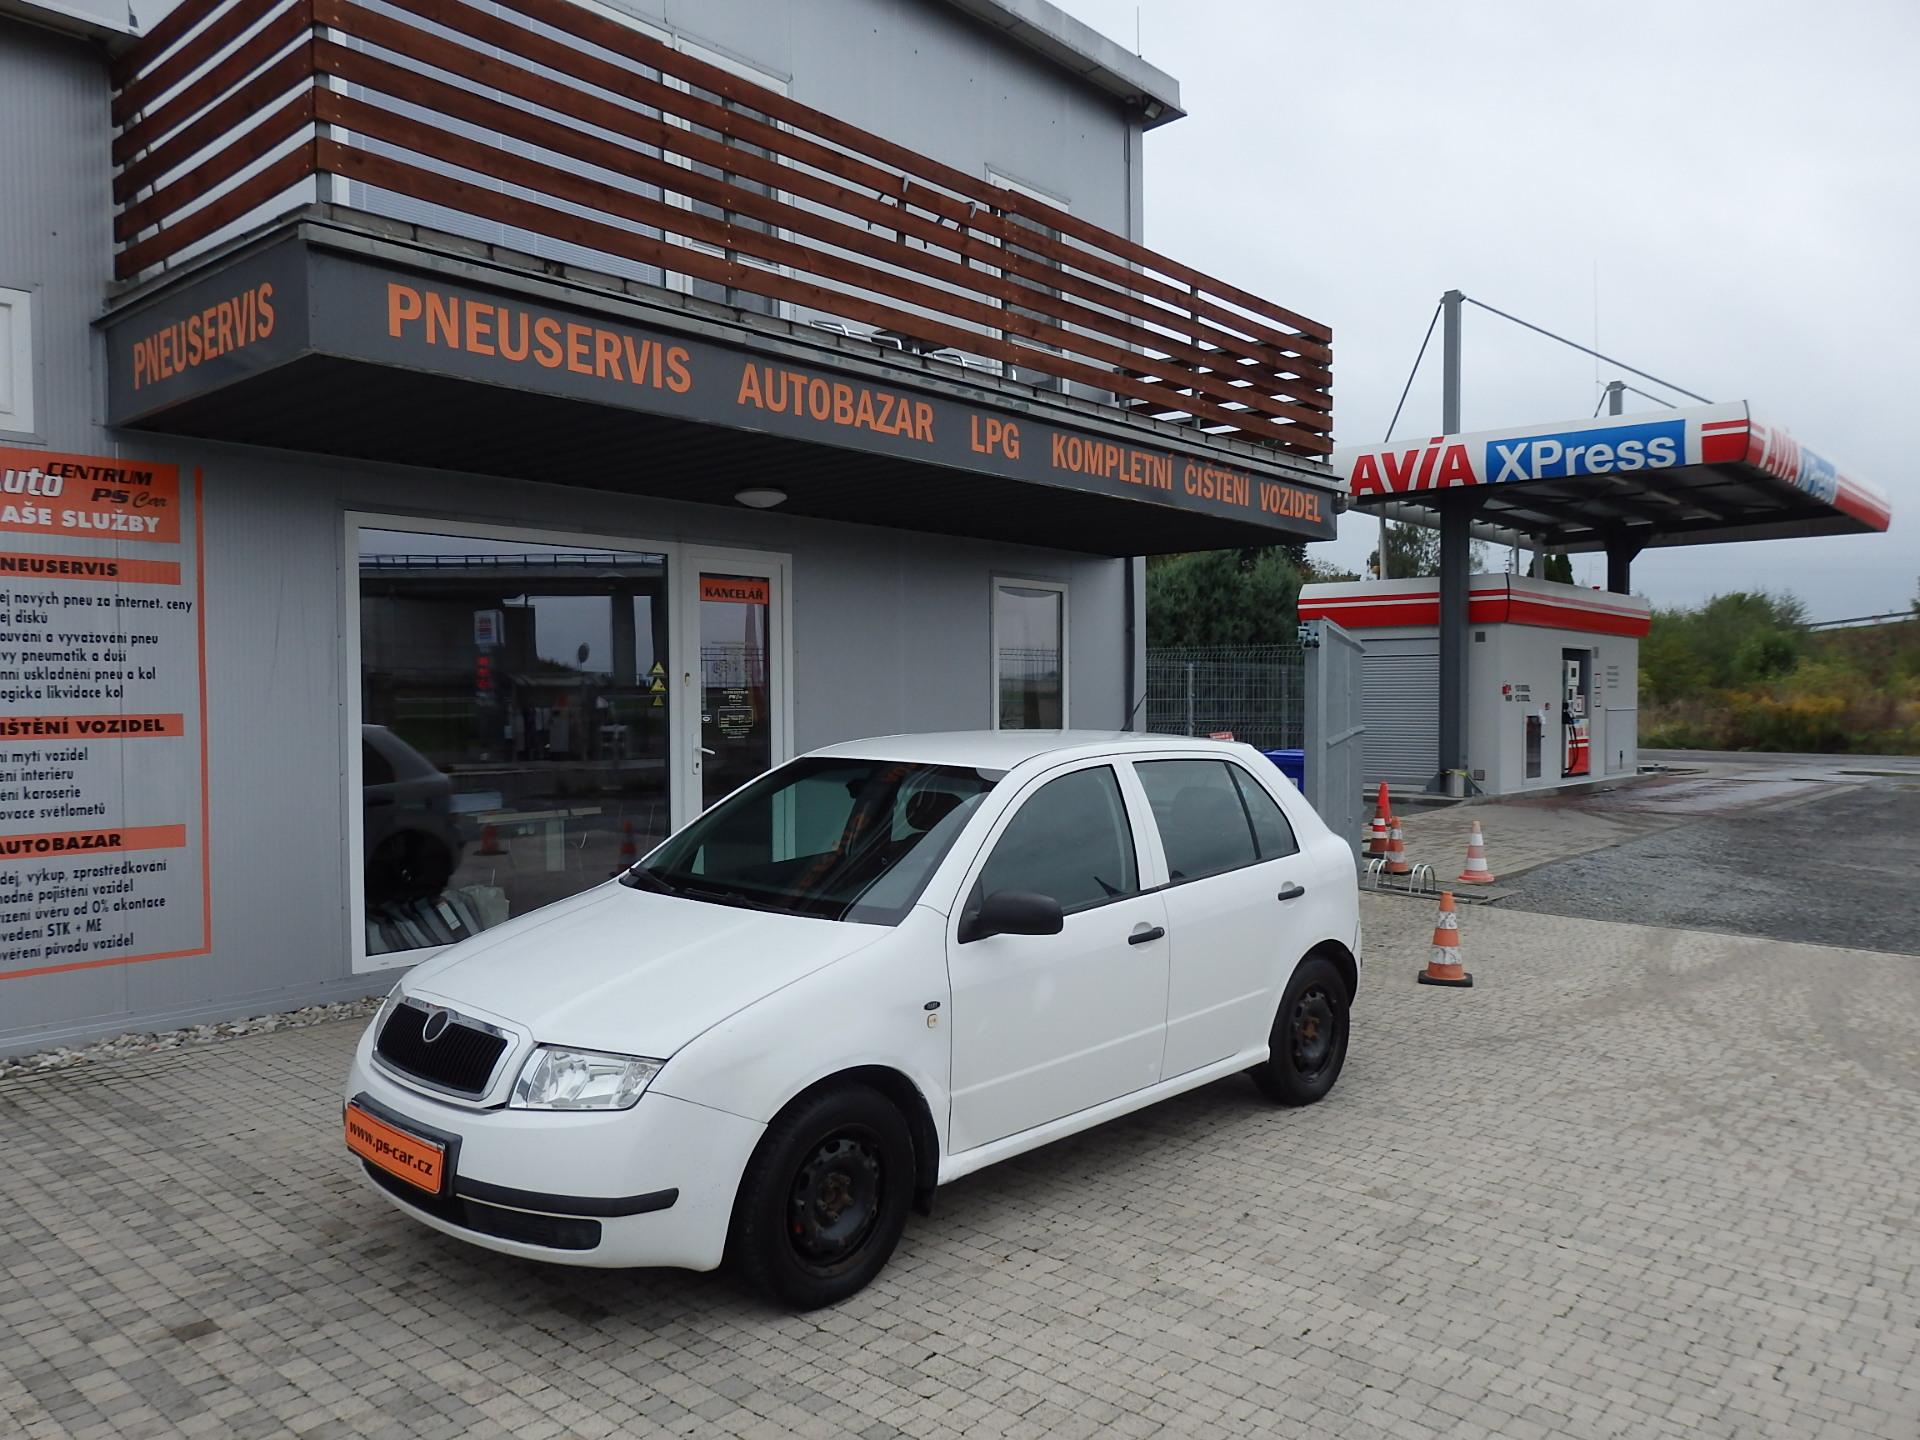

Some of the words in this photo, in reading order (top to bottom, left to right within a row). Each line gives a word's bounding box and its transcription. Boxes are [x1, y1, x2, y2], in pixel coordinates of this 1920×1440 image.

[133, 282, 274, 390] PNEUSERVIS
[387, 283, 692, 393] PNEUSERVIS
[737, 363, 934, 443] AUTOBAZAR
[971, 416, 1020, 460] LPG
[1051, 433, 1173, 490] KOMPLETNÍ
[1184, 456, 1250, 507] ČIŠTĚNÍ
[1259, 482, 1322, 523] VOZIDEL
[1495, 436, 1677, 483] XPress
[0, 466, 64, 497] uto
[47, 462, 153, 486] CENTRUM
[91, 487, 131, 504] PS
[62, 509, 160, 533] SLUŽBY
[0, 557, 119, 577] NEUSERVIS
[14, 591, 60, 609] nových
[64, 596, 92, 608] pneu
[97, 597, 111, 607] za
[167, 600, 193, 613] ceny
[15, 610, 48, 624] disků
[46, 633, 54, 643] a
[58, 632, 128, 646] vyvažování
[131, 634, 159, 647] pneu
[22, 648, 87, 664] pneumatik
[91, 652, 99, 662] a
[104, 648, 127, 662] duší
[24, 666, 91, 681] uskladnění
[95, 670, 123, 683] pneu
[127, 672, 134, 680] a
[139, 666, 156, 680] kol
[46, 685, 102, 700] likvidace
[106, 684, 124, 698] kol
[76, 719, 165, 734] VOZIDEL
[45, 747, 89, 762] vozidel
[21, 766, 74, 781] interiéru
[23, 785, 81, 800] karoserie
[40, 803, 106, 818] světlometů
[73, 859, 168, 882] zprostředkování
[38, 885, 89, 904] pojištění
[93, 878, 134, 896] vozidel
[35, 905, 70, 920] úvěru
[73, 903, 88, 916] od
[92, 899, 109, 914] 0%
[113, 897, 166, 912] akontace
[47, 921, 71, 938] STK
[86, 918, 102, 933] ME
[45, 939, 89, 959] původu
[93, 932, 134, 948] vozidel
[349, 1122, 433, 1176] www.ps-car.cz
